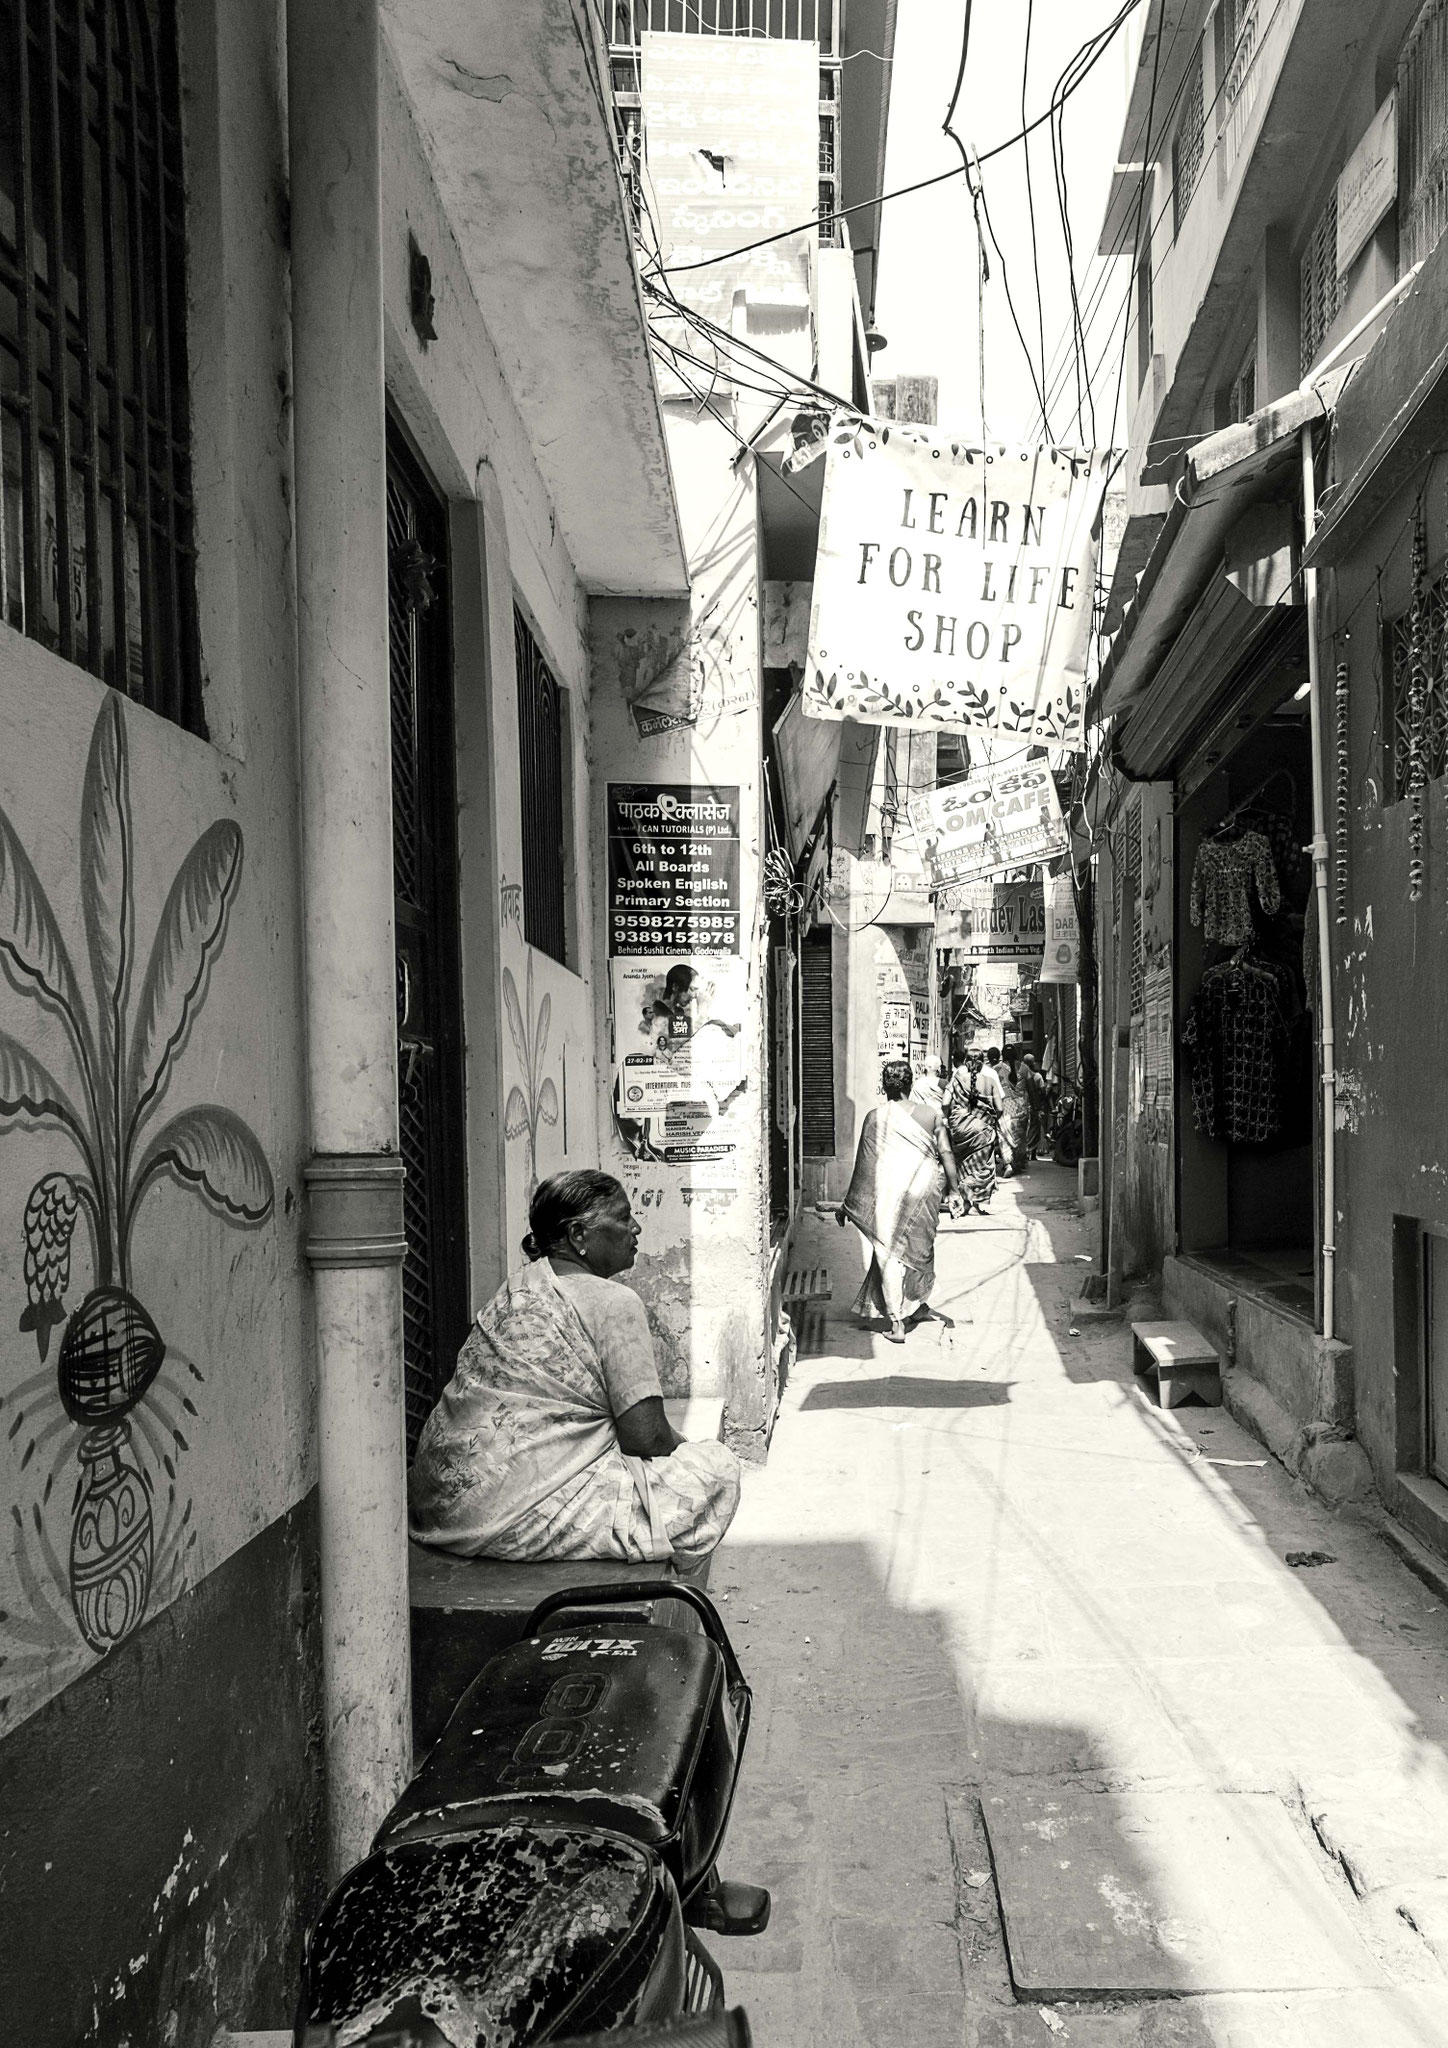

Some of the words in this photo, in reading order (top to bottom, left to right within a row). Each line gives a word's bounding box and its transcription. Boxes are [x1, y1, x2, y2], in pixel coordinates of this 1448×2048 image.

[901, 489, 1046, 546] LEARN
[857, 543, 942, 594] FOR
[980, 562, 1078, 610] LIFE
[904, 610, 1022, 663] SHOP
[617, 802, 660, 819] पाठक
[675, 796, 731, 820] क्लासेज
[946, 807, 986, 832] OM
[991, 787, 1050, 818] CAFE
[642, 825, 659, 833] CAN
[661, 825, 705, 834] TUTORIALS
[705, 825, 716, 835] (P)
[717, 825, 731, 834] Ltd.
[975, 835, 1008, 852] SOUTH
[1009, 824, 1045, 841] INDIAN
[1001, 830, 1057, 853] AVAILABLE
[633, 843, 655, 855] 6th
[661, 844, 675, 855] to
[680, 844, 712, 856] 12th
[636, 861, 653, 871] All
[659, 861, 710, 873] Boards
[617, 878, 670, 890] Spoken
[675, 879, 728, 892] English
[615, 895, 671, 908] Primary
[675, 896, 730, 907] Section
[614, 915, 735, 928] 9598275985
[1018, 895, 1046, 935] Las
[614, 931, 735, 944] 9389152978
[618, 946, 642, 954] Behind
[643, 946, 664, 955] Sushil
[978, 946, 994, 954] North
[995, 946, 1014, 954] Indian
[1015, 946, 1028, 954] Pure
[1029, 946, 1042, 955] Veg.
[916, 1001, 929, 1014] PALA
[552, 1635, 580, 1643] NEW
